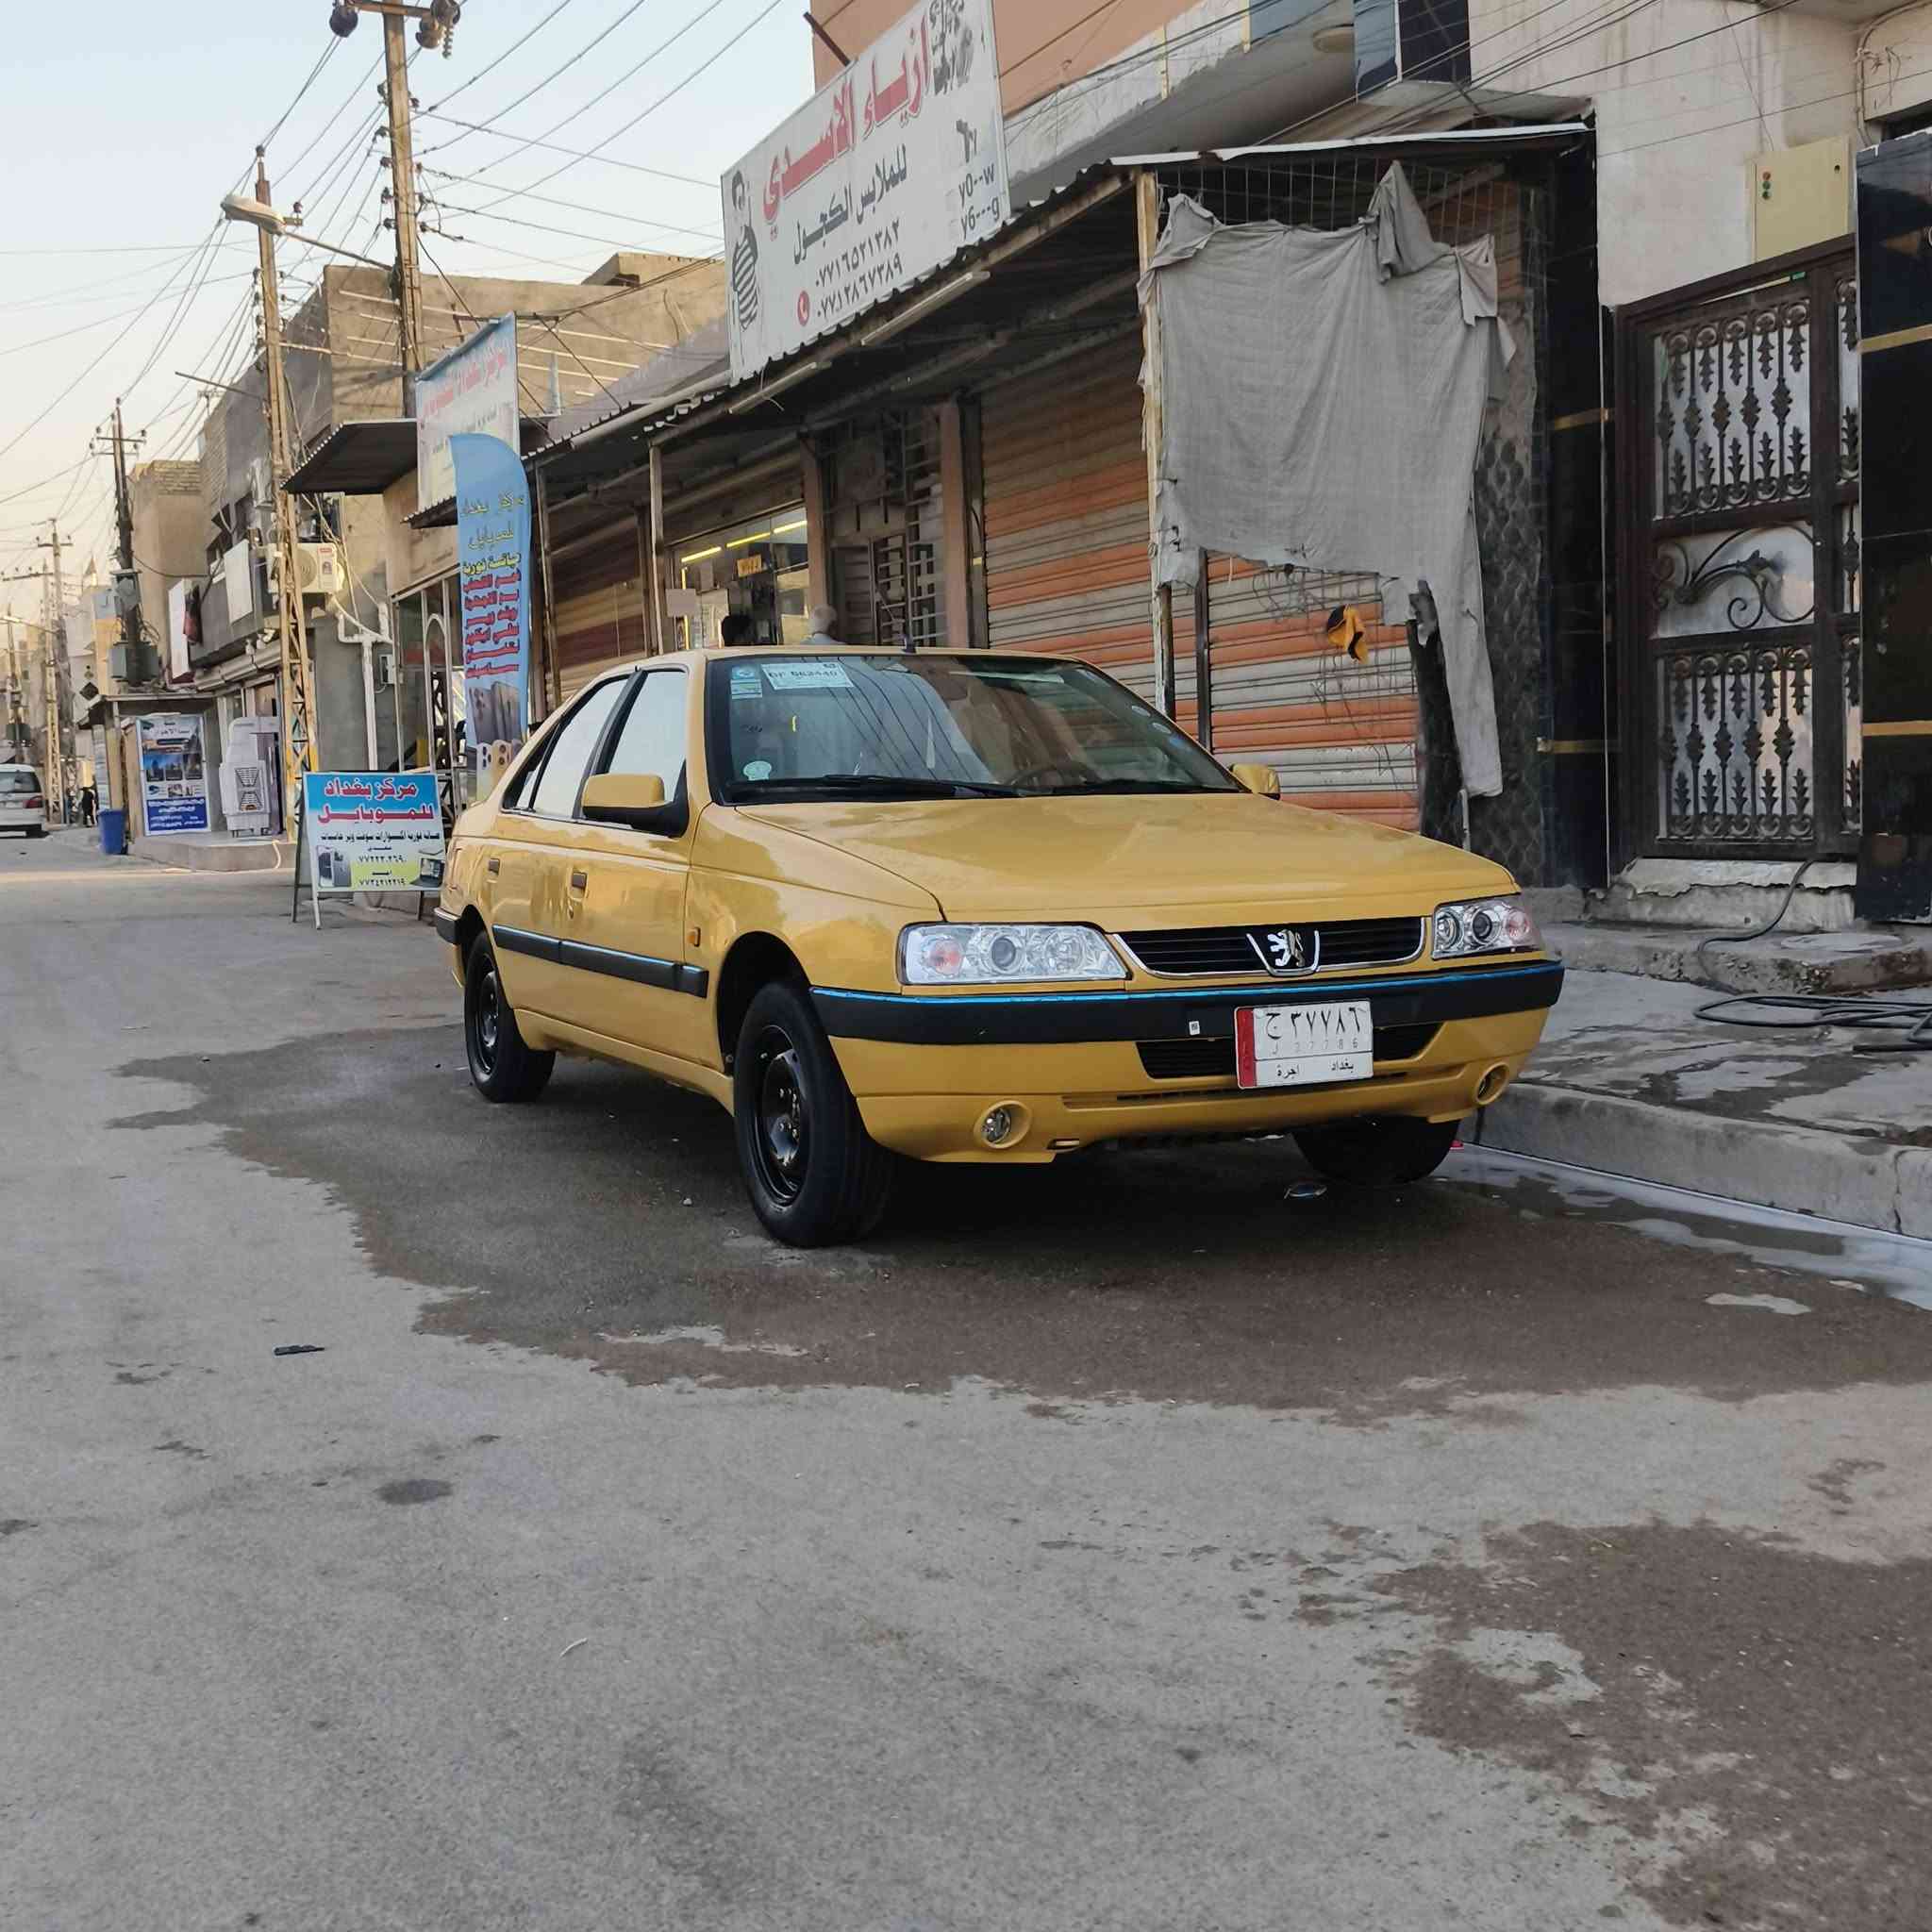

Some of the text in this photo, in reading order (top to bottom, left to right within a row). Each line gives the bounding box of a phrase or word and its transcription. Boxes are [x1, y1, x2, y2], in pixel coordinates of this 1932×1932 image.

[325, 777, 419, 801] مركز بغداد
[318, 803, 436, 824] للموبايل
[1331, 1058, 1355, 1074] بغداد
